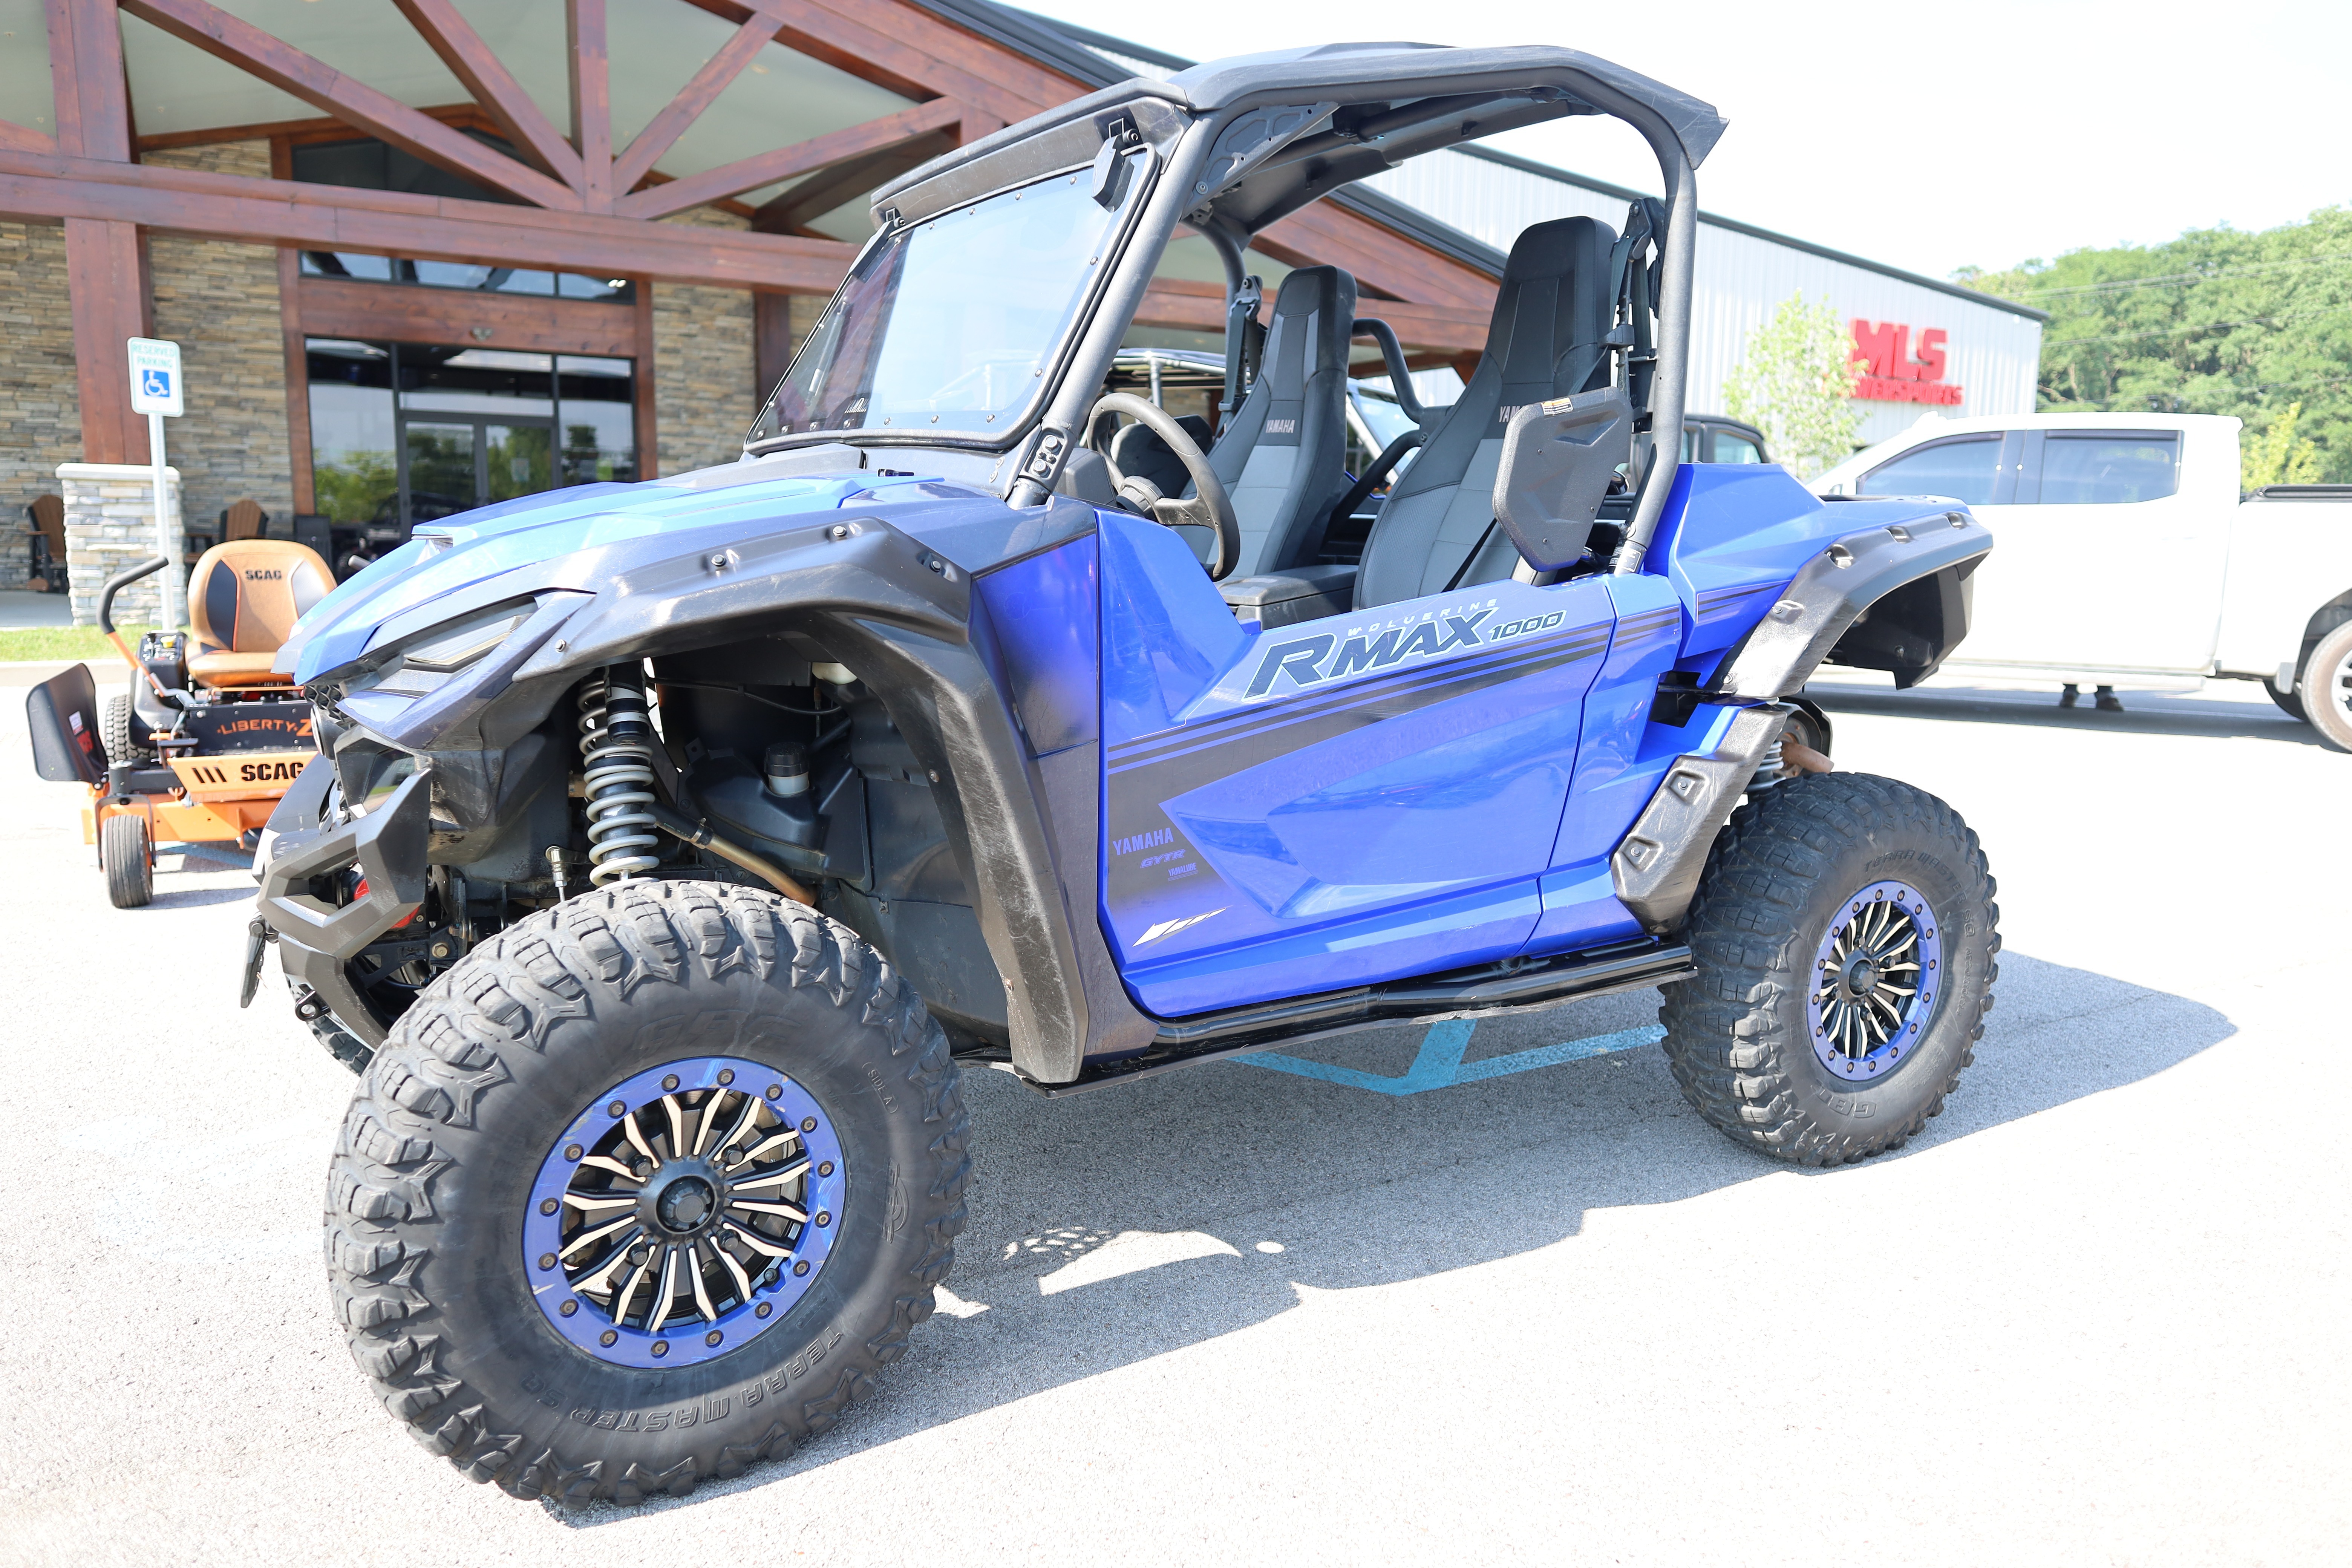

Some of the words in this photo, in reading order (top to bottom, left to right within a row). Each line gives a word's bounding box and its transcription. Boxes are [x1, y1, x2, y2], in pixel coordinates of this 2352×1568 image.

[133, 343, 175, 357] RESERVED
[1848, 317, 1948, 381] MLS
[137, 356, 173, 368] PARKING
[1499, 406, 1522, 423] YAM
[1265, 419, 1295, 433] YAMAHA
[245, 570, 282, 580] SCAG
[1241, 607, 1500, 702] RMAX
[1488, 609, 1567, 643] 1000
[220, 718, 295, 735] LIBERTY
[297, 718, 313, 737] Z
[241, 762, 304, 781] SCAG
[1112, 827, 1174, 856] YAMAHA
[1140, 848, 1186, 869] GYTR
[1864, 850, 1916, 873] TERRA
[1168, 862, 1197, 877] YAMALUBE
[745, 1326, 844, 1409] TERRA
[570, 1396, 730, 1433] MASTER
